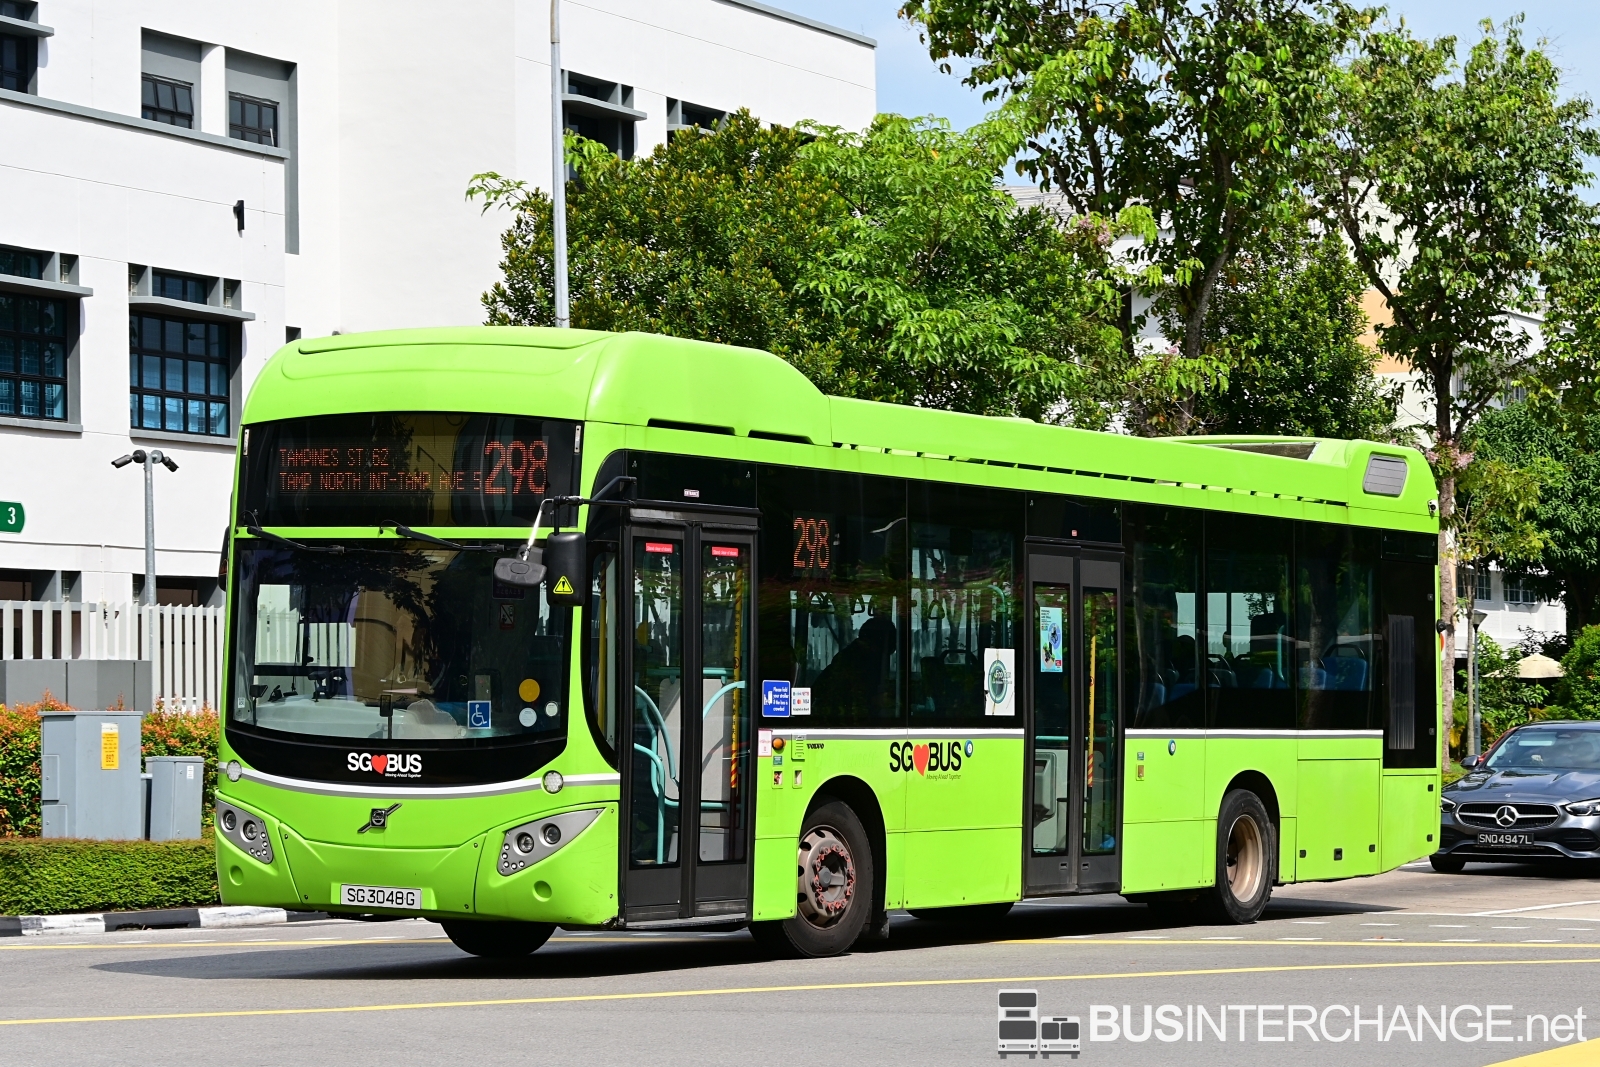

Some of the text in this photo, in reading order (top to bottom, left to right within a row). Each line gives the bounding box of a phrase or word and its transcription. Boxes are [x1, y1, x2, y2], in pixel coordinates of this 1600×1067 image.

[279, 448, 389, 466] TAMPINES ST 62
[484, 440, 548, 494] 298
[279, 472, 482, 490] TAMP NORTH INT-TAMP AVE 5
[7, 506, 16, 525] 3
[793, 517, 830, 569] 298
[347, 752, 423, 773] SG BUS
[889, 741, 914, 773] SG
[927, 741, 962, 772] BUS
[926, 774, 939, 782] Moving
[948, 773, 962, 781] Together
[347, 888, 415, 906] SG3048G
